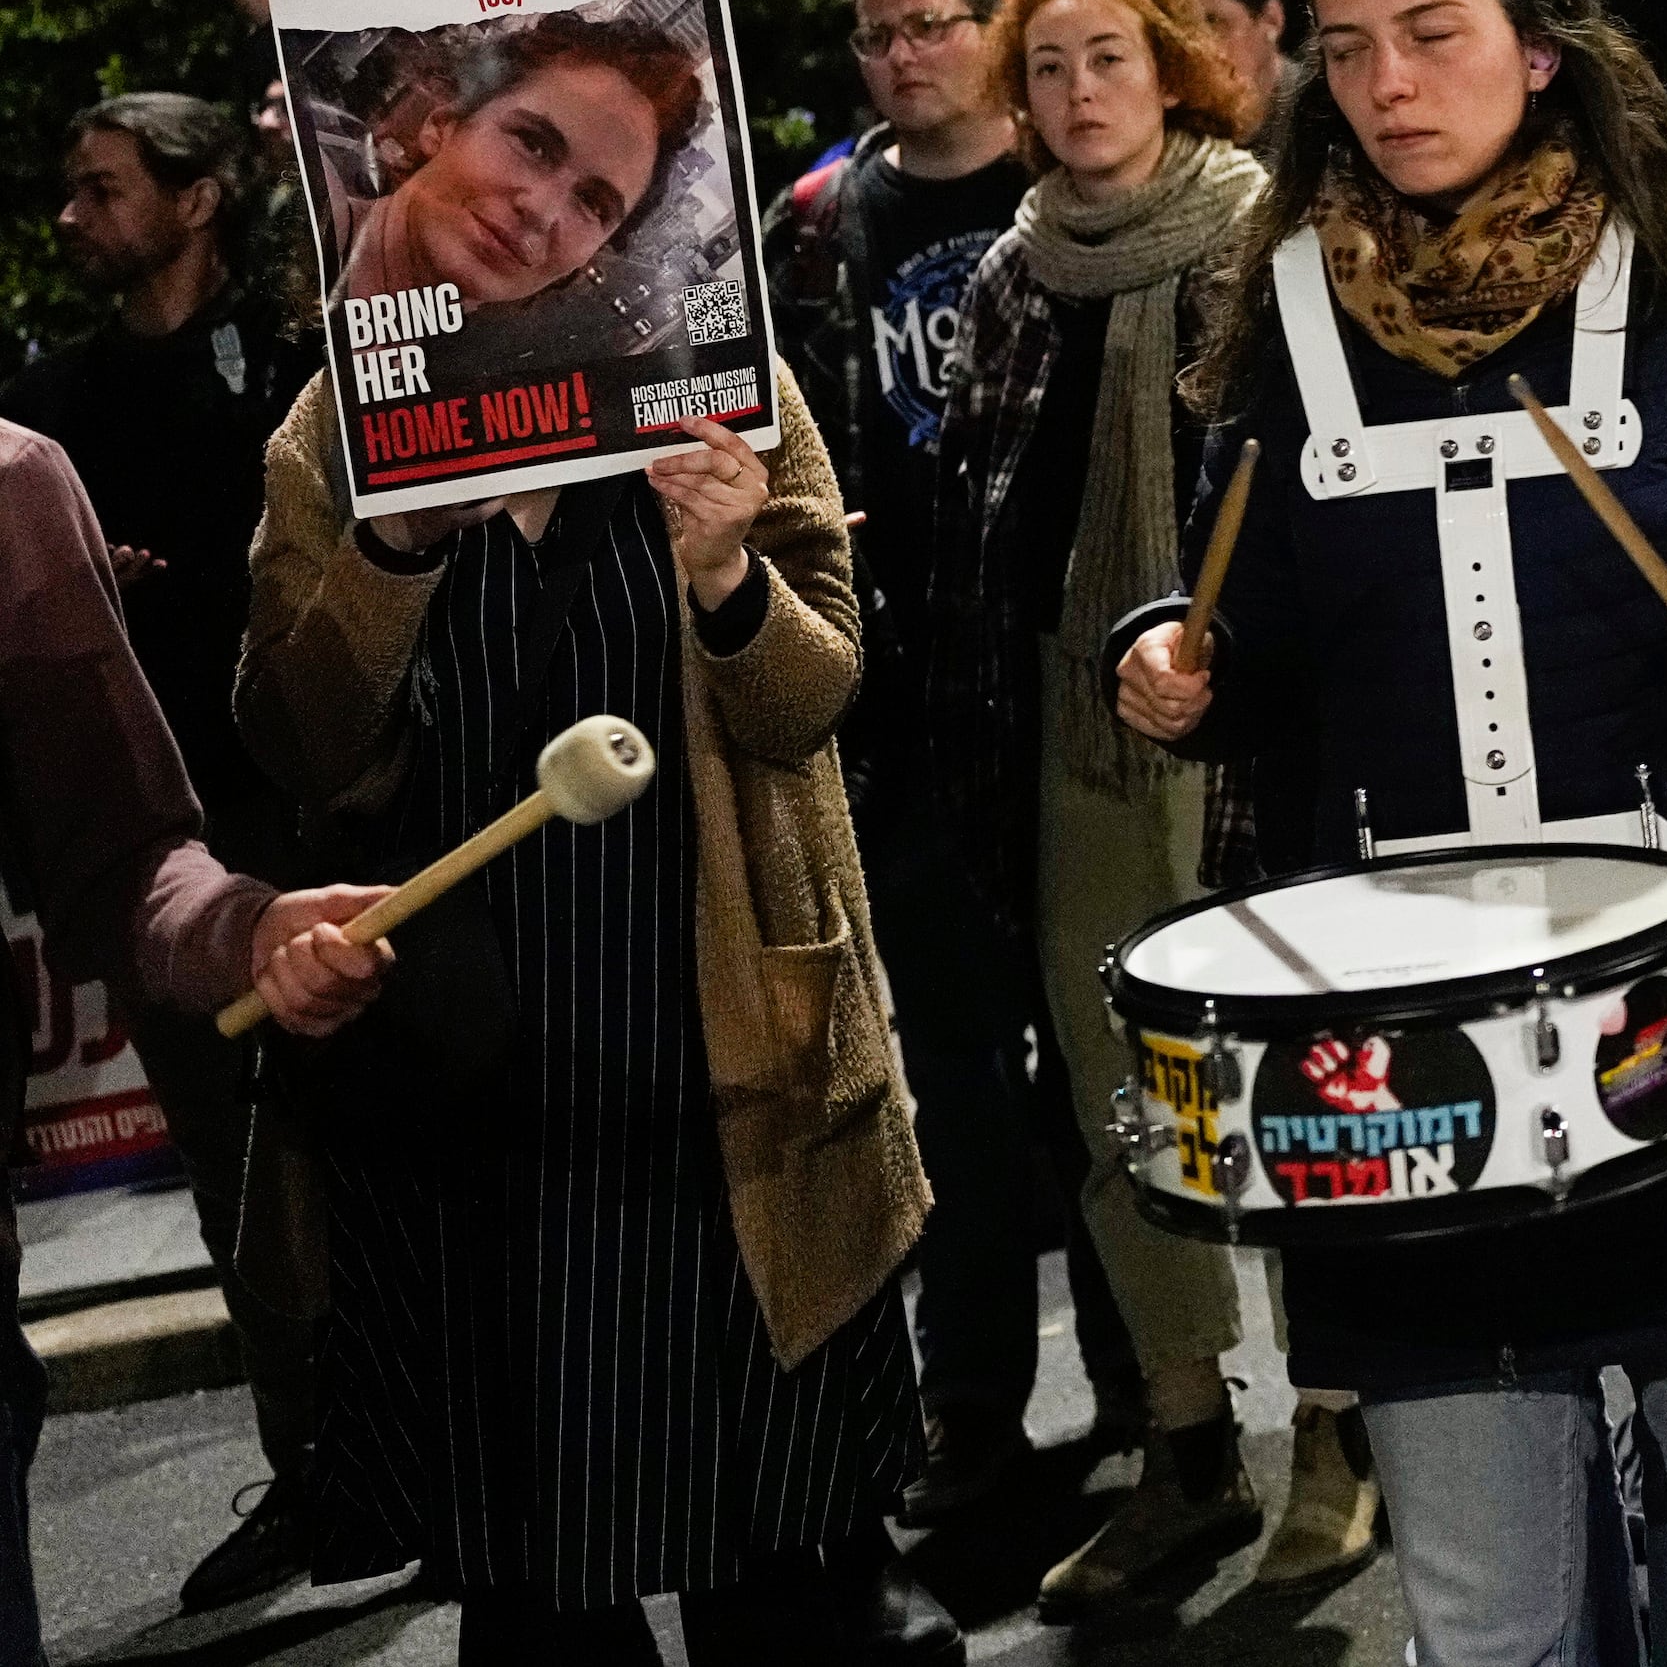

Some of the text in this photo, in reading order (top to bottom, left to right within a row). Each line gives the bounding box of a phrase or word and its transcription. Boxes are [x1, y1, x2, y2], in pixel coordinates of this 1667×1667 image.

[344, 282, 463, 349] BRING
[352, 344, 431, 405] HER
[631, 366, 757, 403] HOSTAGES AND MISSING
[363, 371, 593, 464] HOME NOW!
[635, 385, 759, 429] FAMILIES FORUM
[1260, 1100, 1483, 1157] דמוקרטיה
[1275, 1143, 1459, 1201] או מרד
